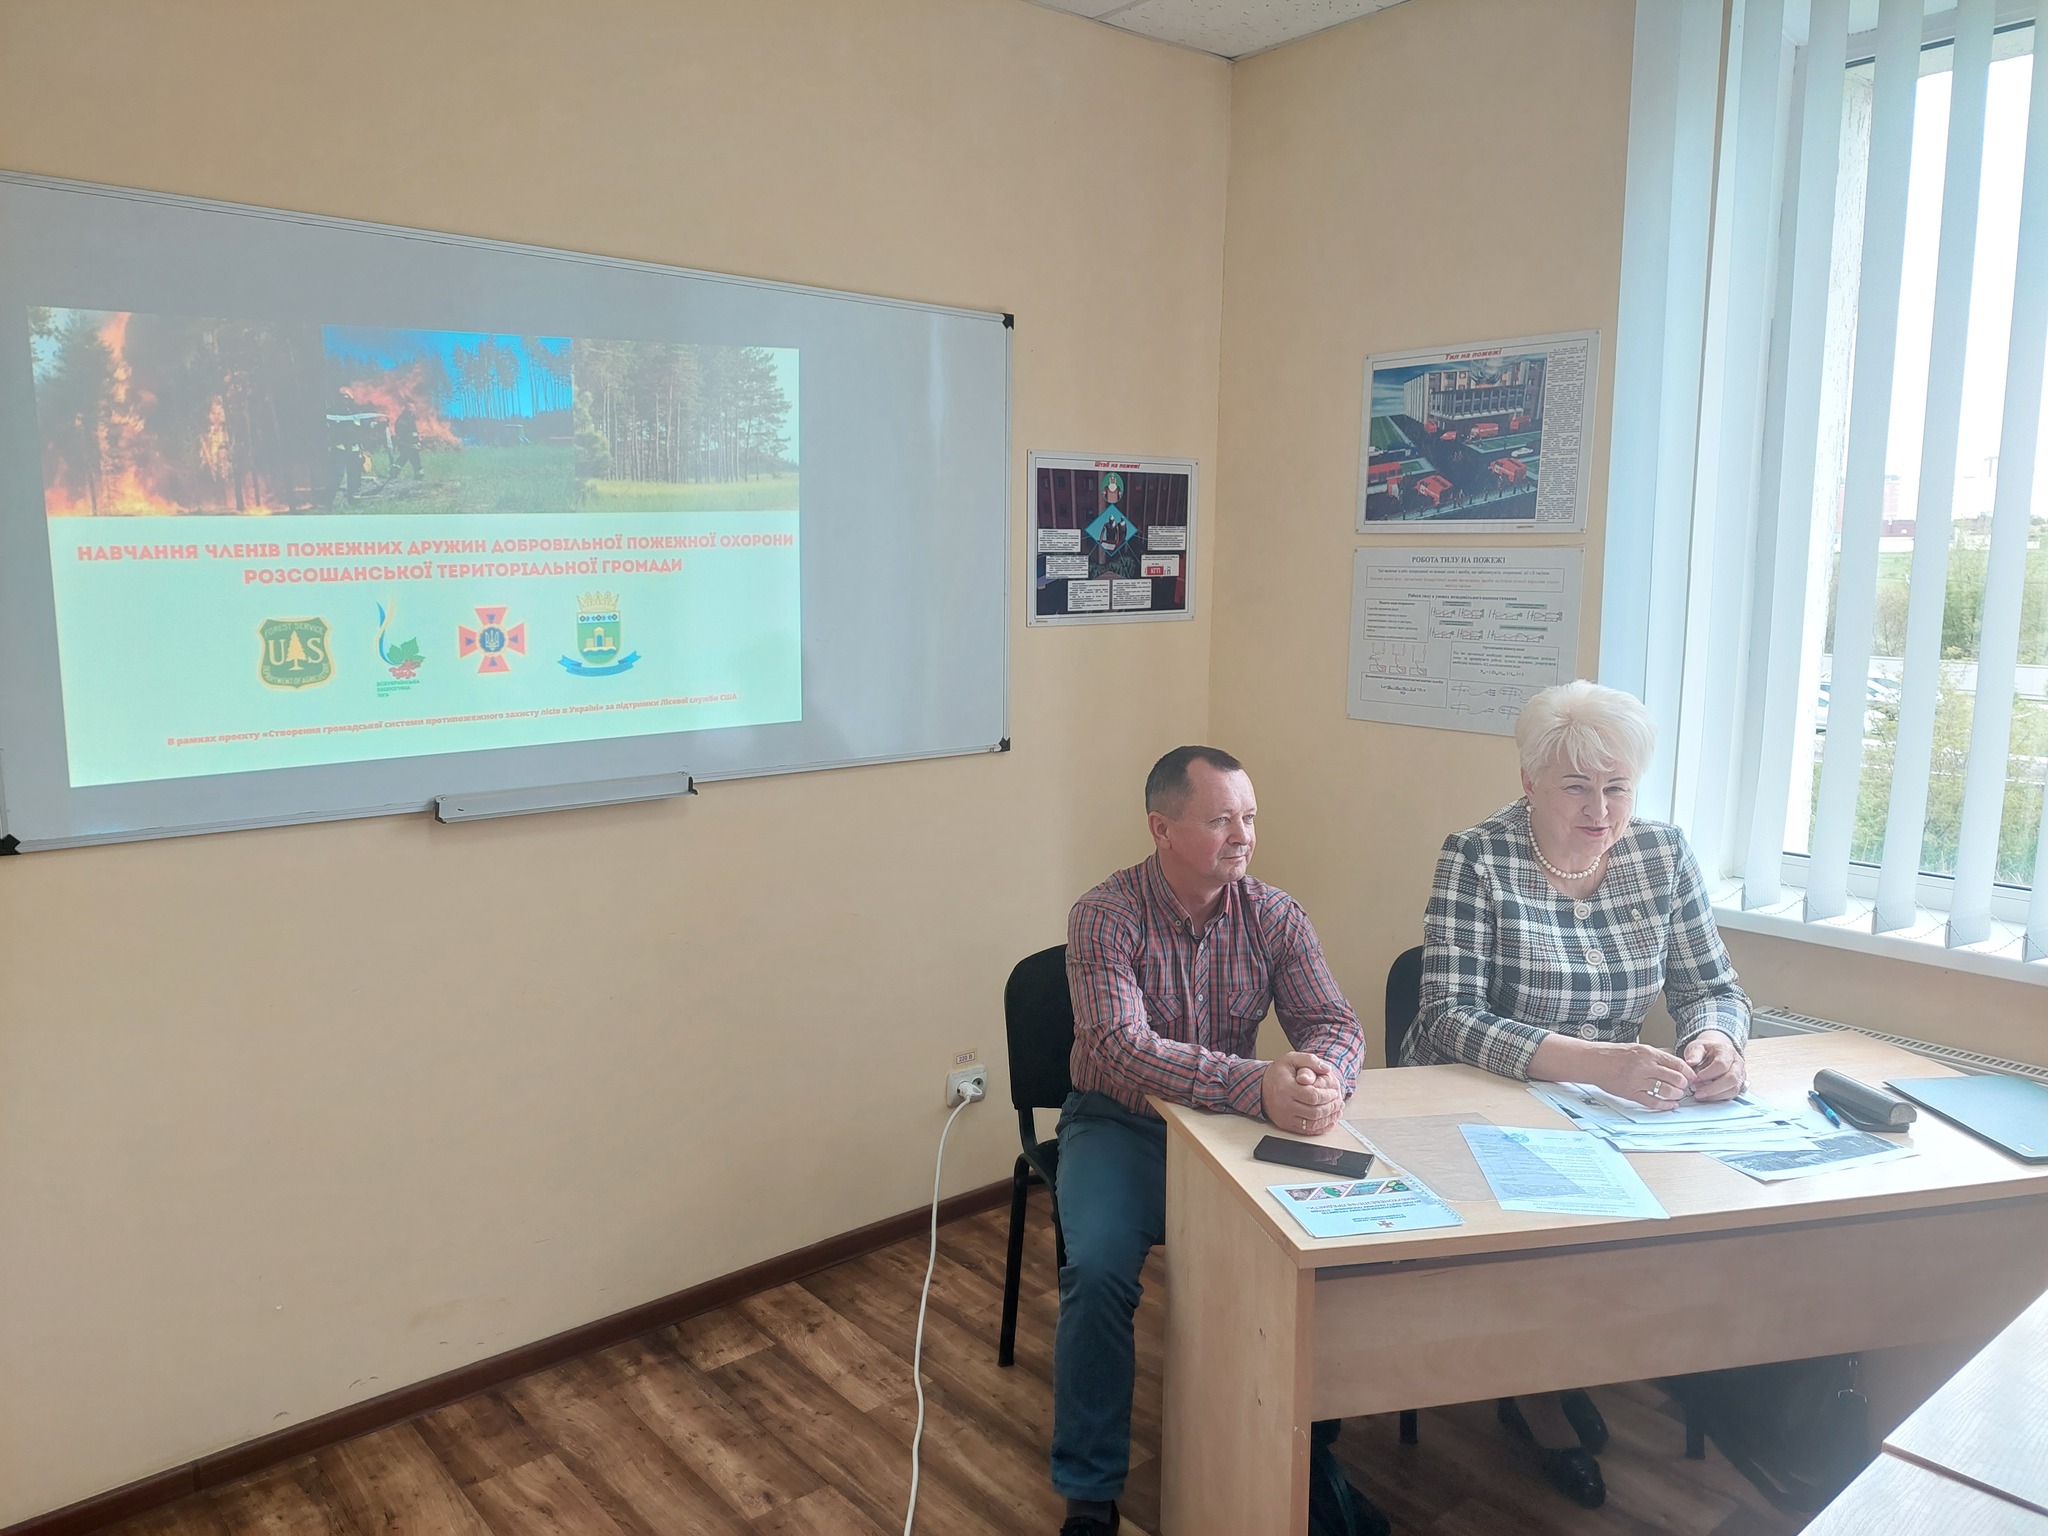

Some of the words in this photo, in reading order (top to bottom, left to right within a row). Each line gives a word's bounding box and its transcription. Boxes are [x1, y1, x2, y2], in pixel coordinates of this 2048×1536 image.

[77, 544, 199, 561] НАВЧАННЯ
[205, 543, 281, 558] ЧЛЕНІВ
[287, 540, 404, 557] ПОЖЕЖНИХ
[407, 539, 487, 555] ДРУЖИН
[491, 533, 623, 553] ДОБРОВІЛЬНОЇ
[627, 531, 717, 550] ПОЖЕЖНОЇ
[720, 533, 793, 548] ОХОРОНИ
[244, 561, 433, 584] РОЗСОШАНСЬКОЇ
[437, 557, 598, 578] ТЕРИТОРІАЛЬНОЇ
[602, 558, 683, 574] ГРОМАДИ
[1411, 556, 1439, 564] РОБОТА
[1440, 556, 1460, 564] ТИЛУ
[1460, 556, 1472, 564] НА
[1473, 556, 1506, 564] ПОЖЕЖІ
[265, 623, 291, 638] FOREST
[294, 622, 324, 636] SERVICE
[167, 737, 174, 745] В
[176, 734, 216, 747] рамках
[262, 727, 321, 738] «Створення
[322, 721, 383, 734] громадської
[384, 718, 424, 728] системи
[426, 712, 504, 726] протипожежного
[505, 709, 539, 719] захисту
[540, 707, 561, 716] лісів
[605, 703, 614, 711] за
[615, 699, 659, 711] підтримки
[660, 697, 688, 706] Лісової
[689, 695, 719, 705] служби
[719, 693, 737, 702] США
